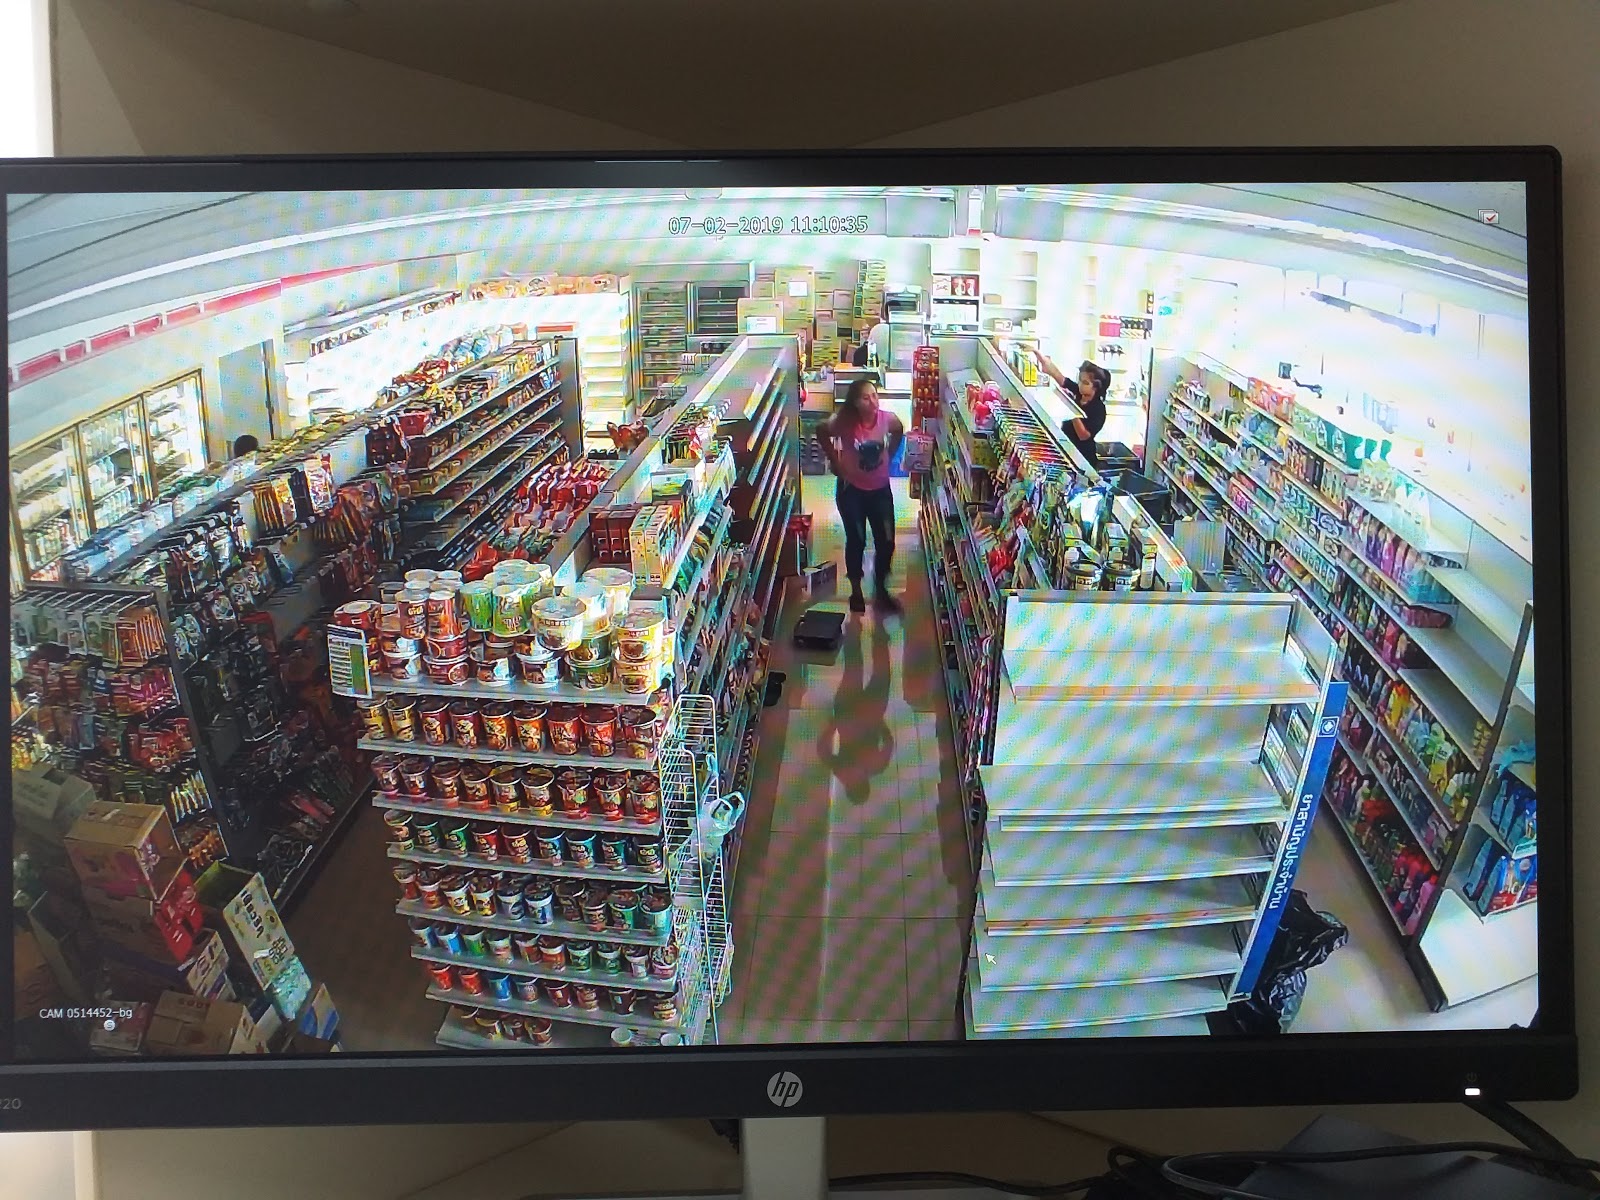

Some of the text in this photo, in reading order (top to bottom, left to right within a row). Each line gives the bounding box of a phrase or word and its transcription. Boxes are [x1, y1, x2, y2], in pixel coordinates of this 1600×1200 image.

[668, 215, 868, 235] 07-02-2019 11:10:35
[1269, 794, 1314, 910] ยาสามัญประจำบ้าน
[39, 1008, 63, 1019] CAM
[769, 1071, 801, 1107] hp
